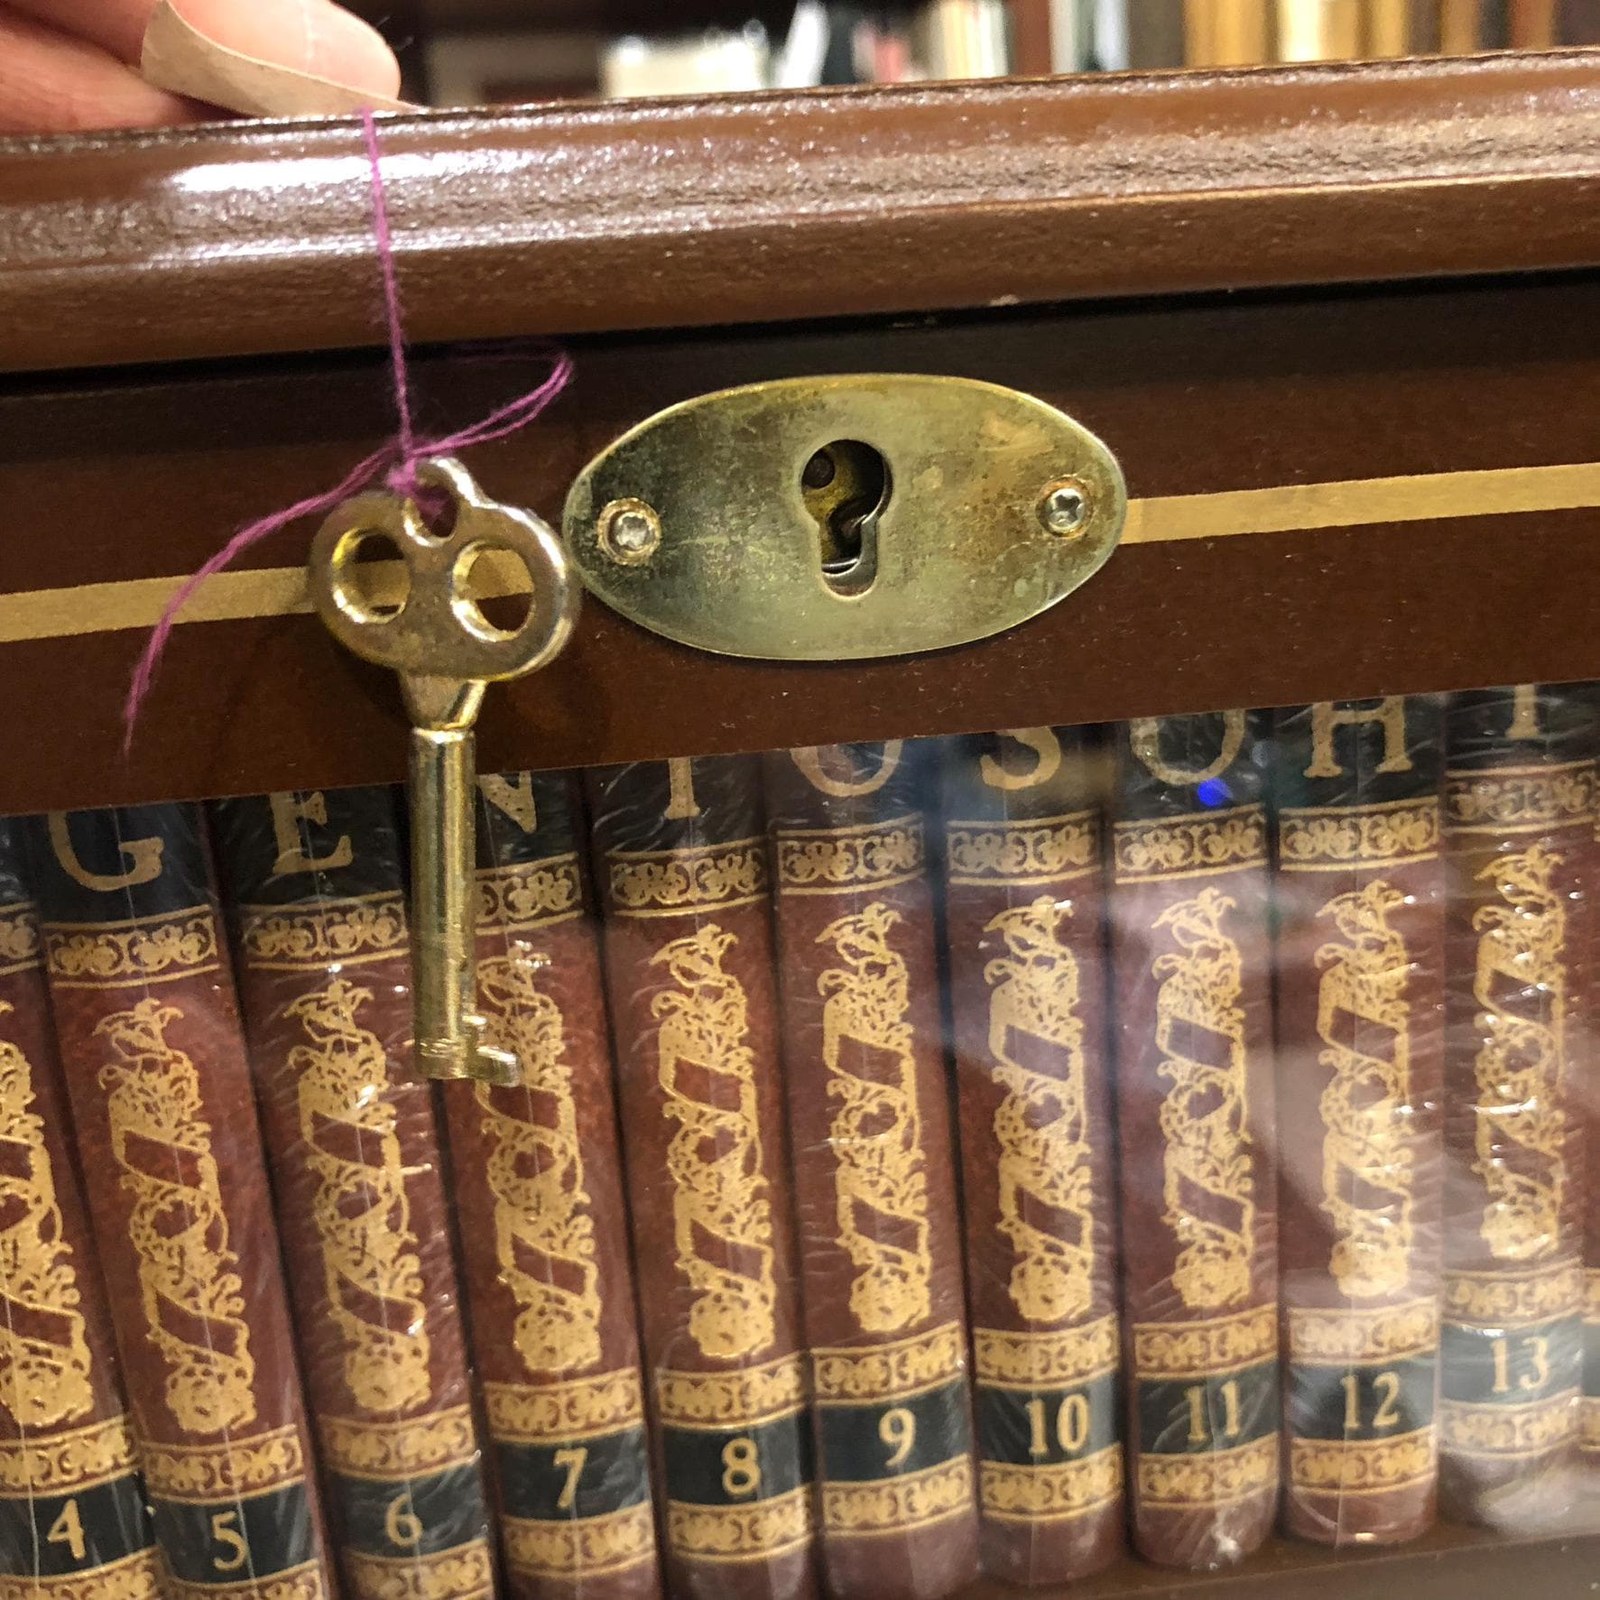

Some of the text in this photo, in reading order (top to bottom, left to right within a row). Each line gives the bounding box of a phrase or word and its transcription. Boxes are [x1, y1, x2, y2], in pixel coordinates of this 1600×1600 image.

[1303, 696, 1413, 778] H
[272, 791, 354, 874] E
[1490, 1336, 1548, 1393] 13
[1028, 1393, 1091, 1456] 10
[1186, 1380, 1242, 1441] 11
[1341, 1371, 1400, 1430] 12
[721, 1437, 761, 1497] 8
[879, 1408, 916, 1468] 9
[553, 1447, 588, 1508] 7
[47, 1500, 85, 1559] 4
[212, 1511, 246, 1573] 5
[385, 1494, 423, 1547] 6
